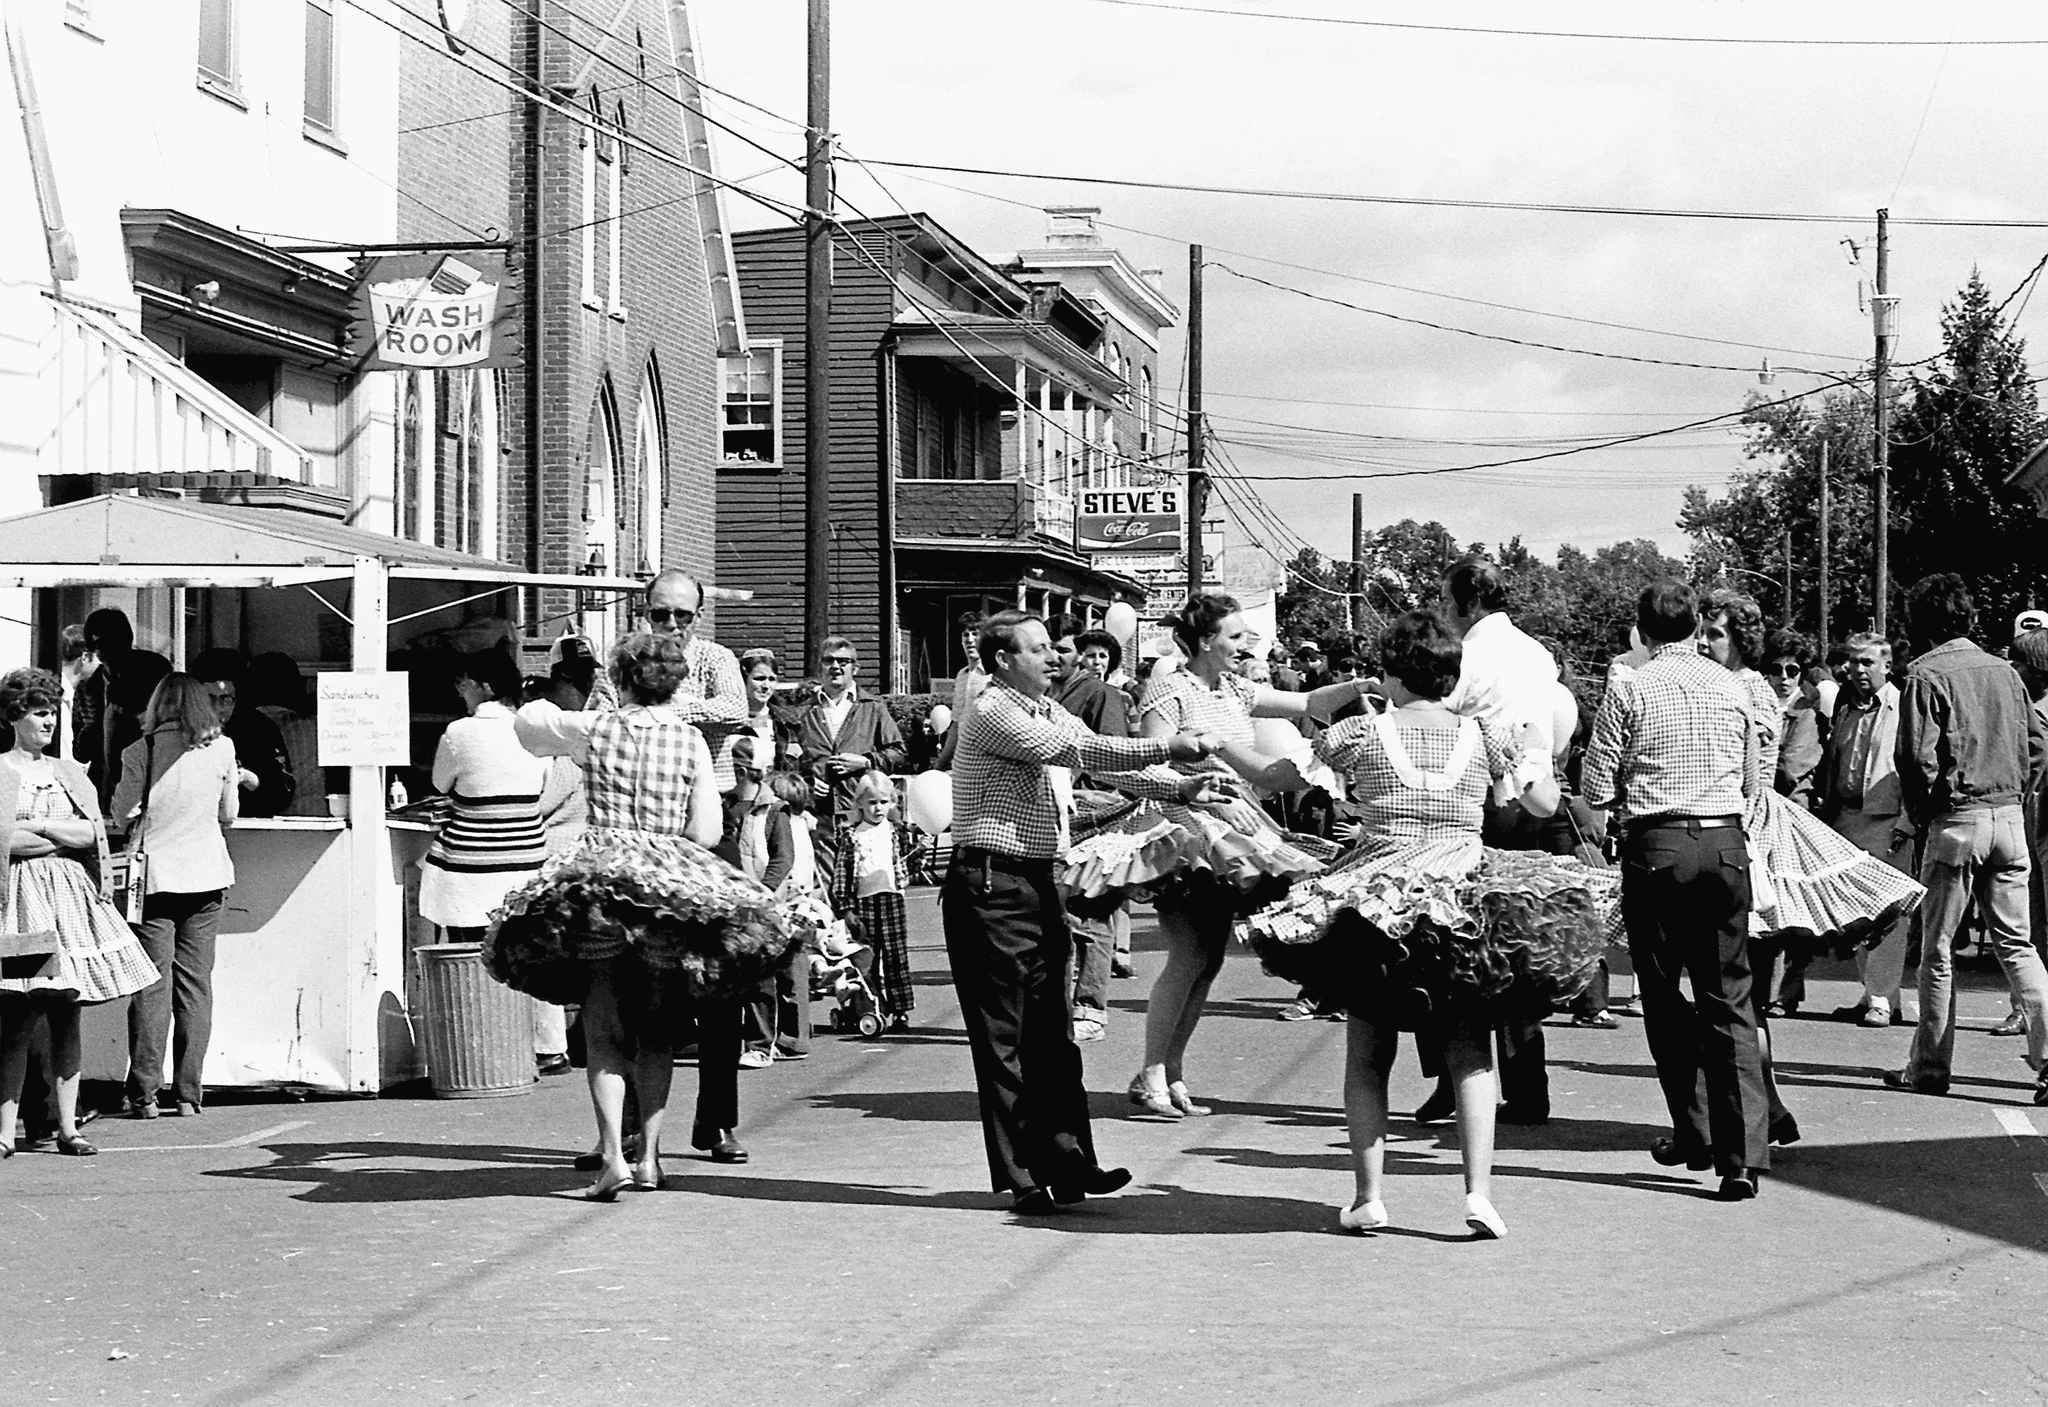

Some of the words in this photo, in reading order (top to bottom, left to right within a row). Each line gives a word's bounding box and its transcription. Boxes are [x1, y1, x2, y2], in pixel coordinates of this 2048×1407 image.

[385, 303, 483, 328] WASH
[386, 329, 482, 356] ROOM
[1084, 490, 1176, 514] STEVE'S
[320, 685, 380, 701] Sandwiches
